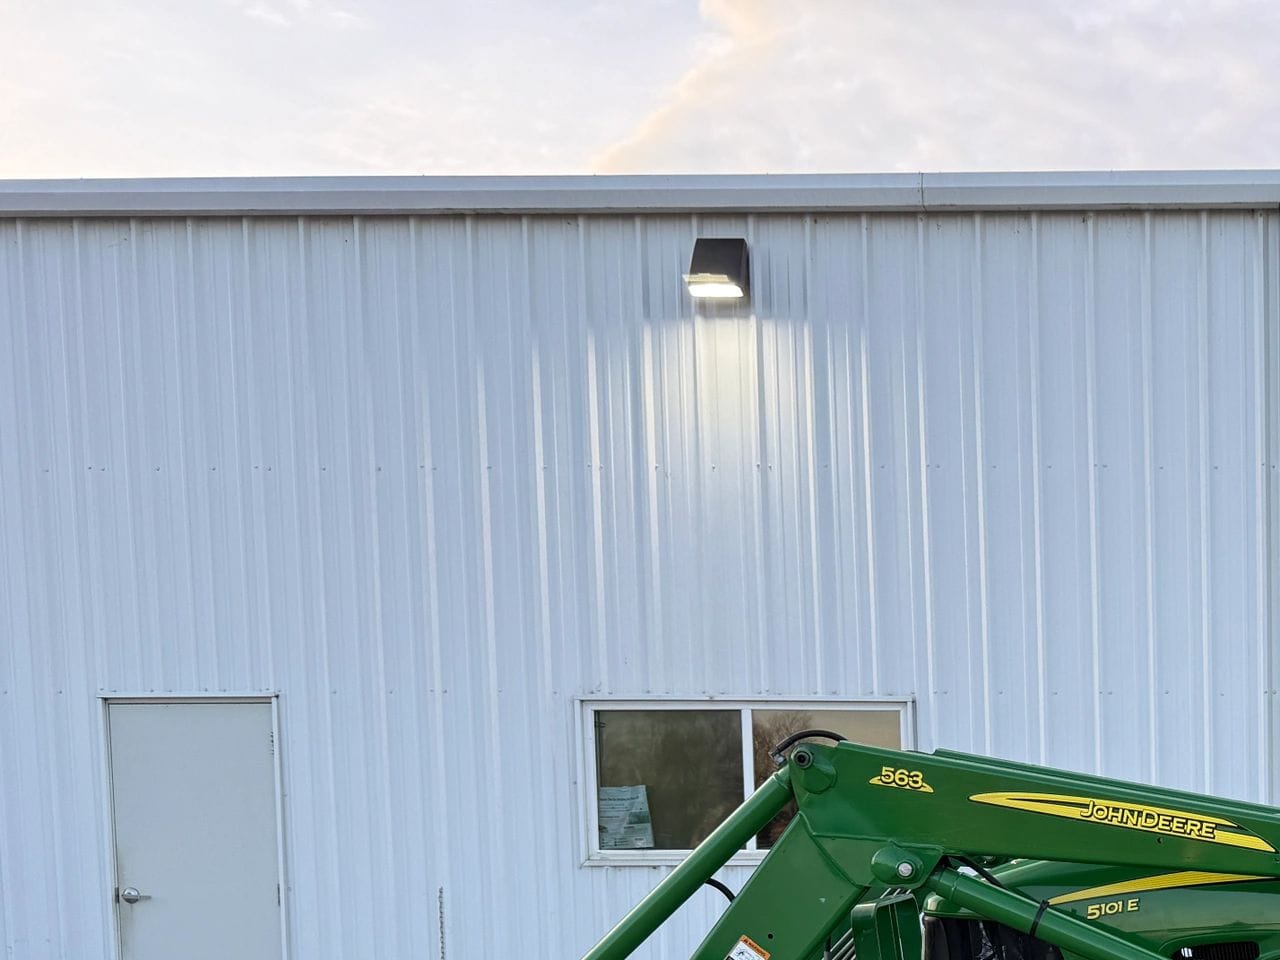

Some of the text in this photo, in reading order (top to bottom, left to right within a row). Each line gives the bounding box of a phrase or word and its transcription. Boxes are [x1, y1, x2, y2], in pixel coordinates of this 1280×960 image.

[881, 766, 923, 788] 563
[1080, 800, 1217, 839] JOHN DEERE
[1087, 898, 1139, 920] 5101 E
